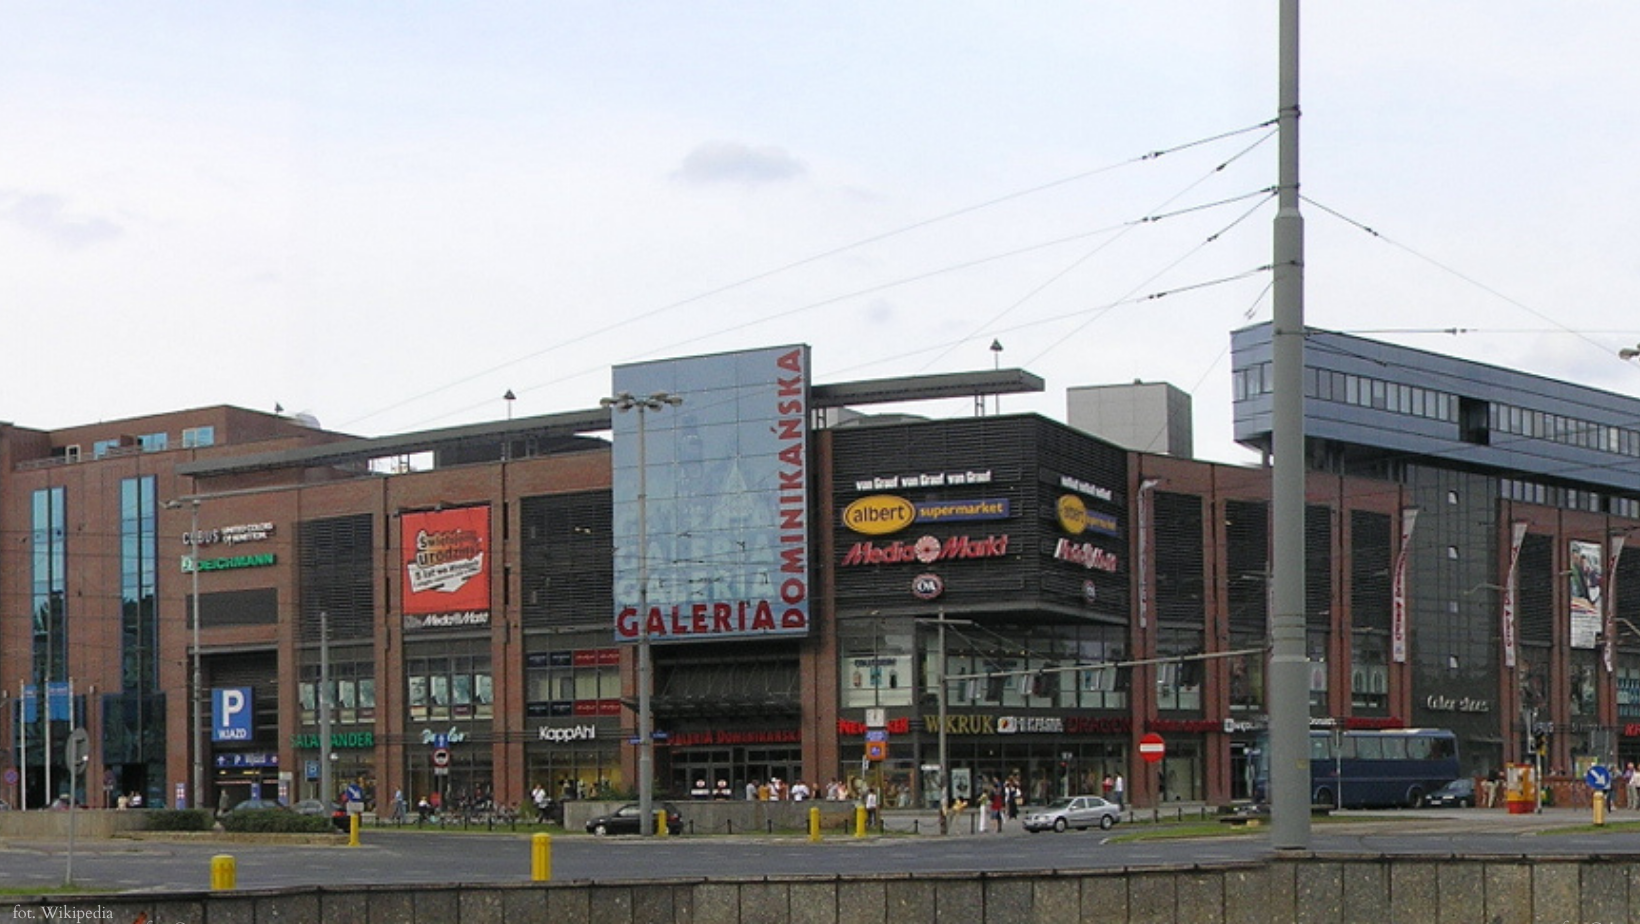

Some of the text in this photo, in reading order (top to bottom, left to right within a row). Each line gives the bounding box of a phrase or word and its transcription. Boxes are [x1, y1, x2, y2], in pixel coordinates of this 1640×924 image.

[771, 347, 807, 629] DOMINIKAŃSKA
[853, 501, 1004, 523] albert supermarket
[198, 553, 274, 571] DEICHMANN
[841, 533, 1010, 566] Media Markt
[616, 600, 776, 637] GALERIA
[223, 690, 244, 727] P
[289, 732, 374, 749] SALAANDER
